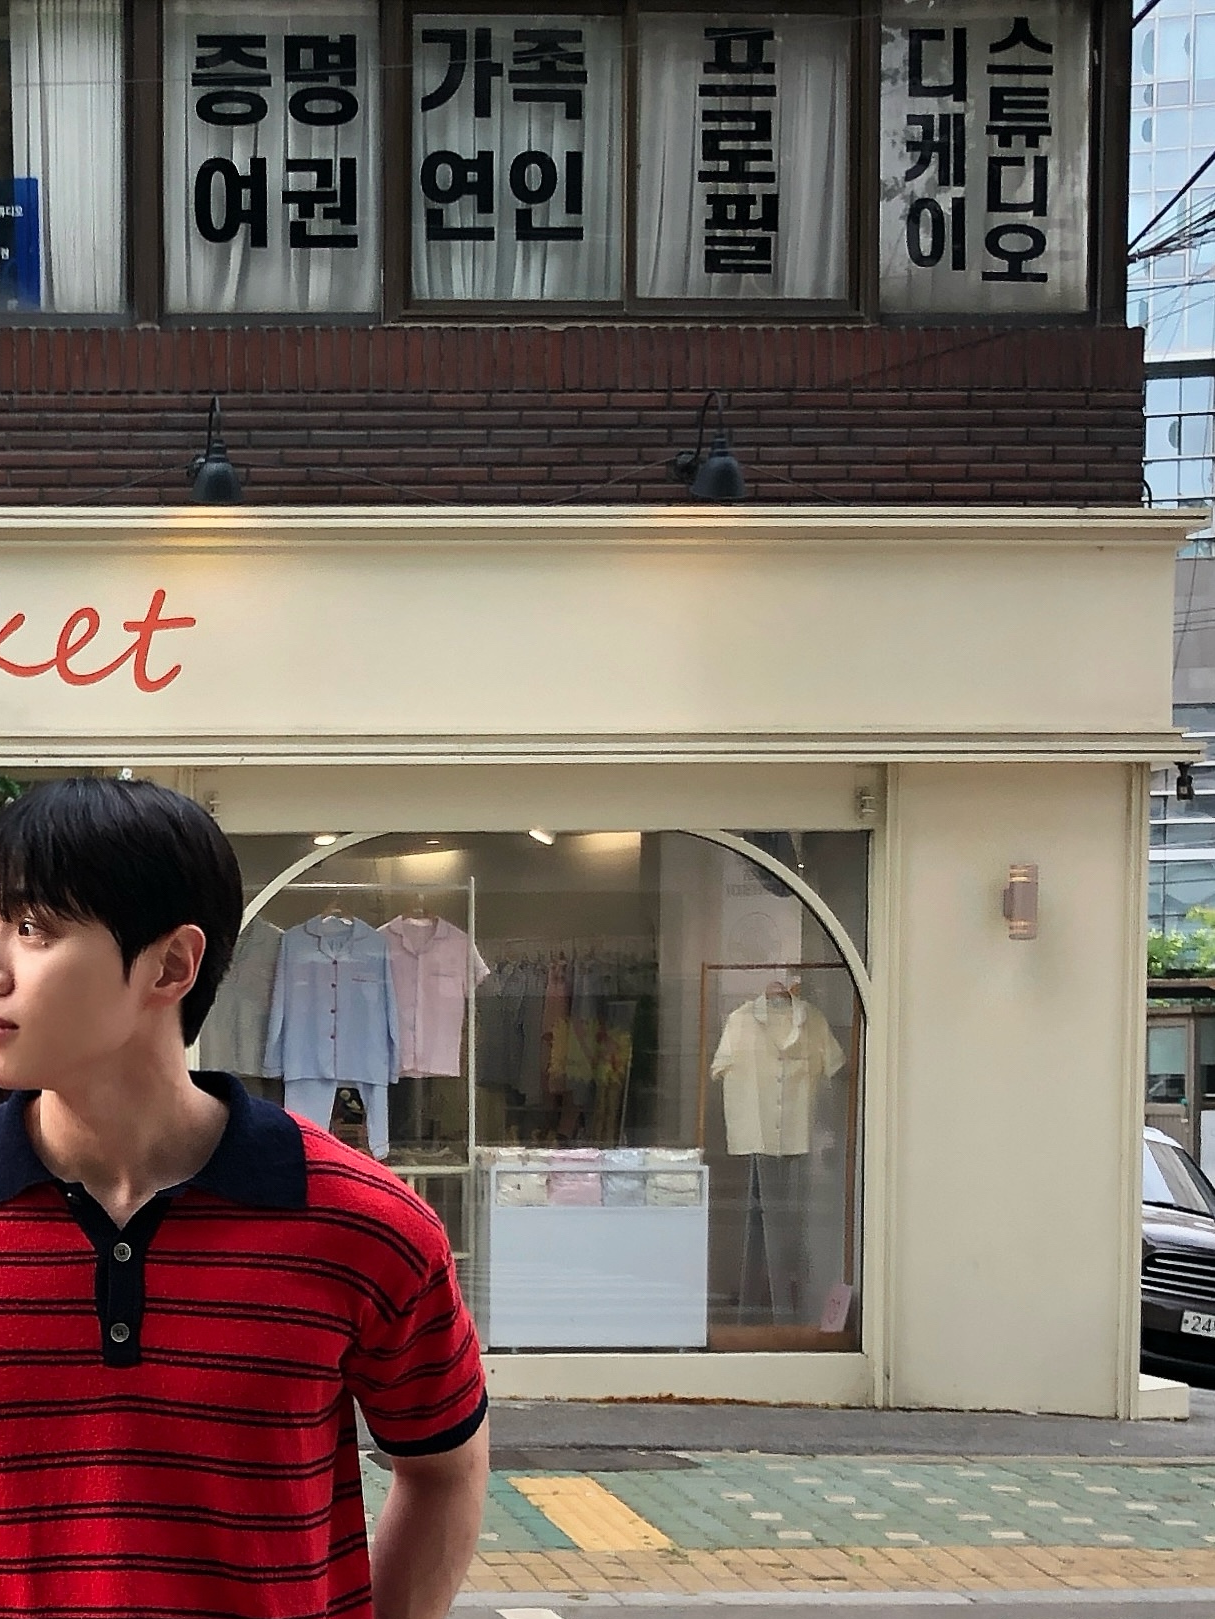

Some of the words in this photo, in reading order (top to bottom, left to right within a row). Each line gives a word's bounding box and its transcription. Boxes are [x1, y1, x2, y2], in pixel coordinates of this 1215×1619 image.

[191, 33, 359, 126] 증명
[420, 28, 588, 120] 가족
[420, 150, 584, 241] 연인
[698, 27, 779, 274] 프로필
[904, 28, 967, 271] 디케이
[982, 17, 1054, 282] 스튜디오
[194, 157, 359, 249] 여권
[1191, 1315, 1215, 1333] 24
